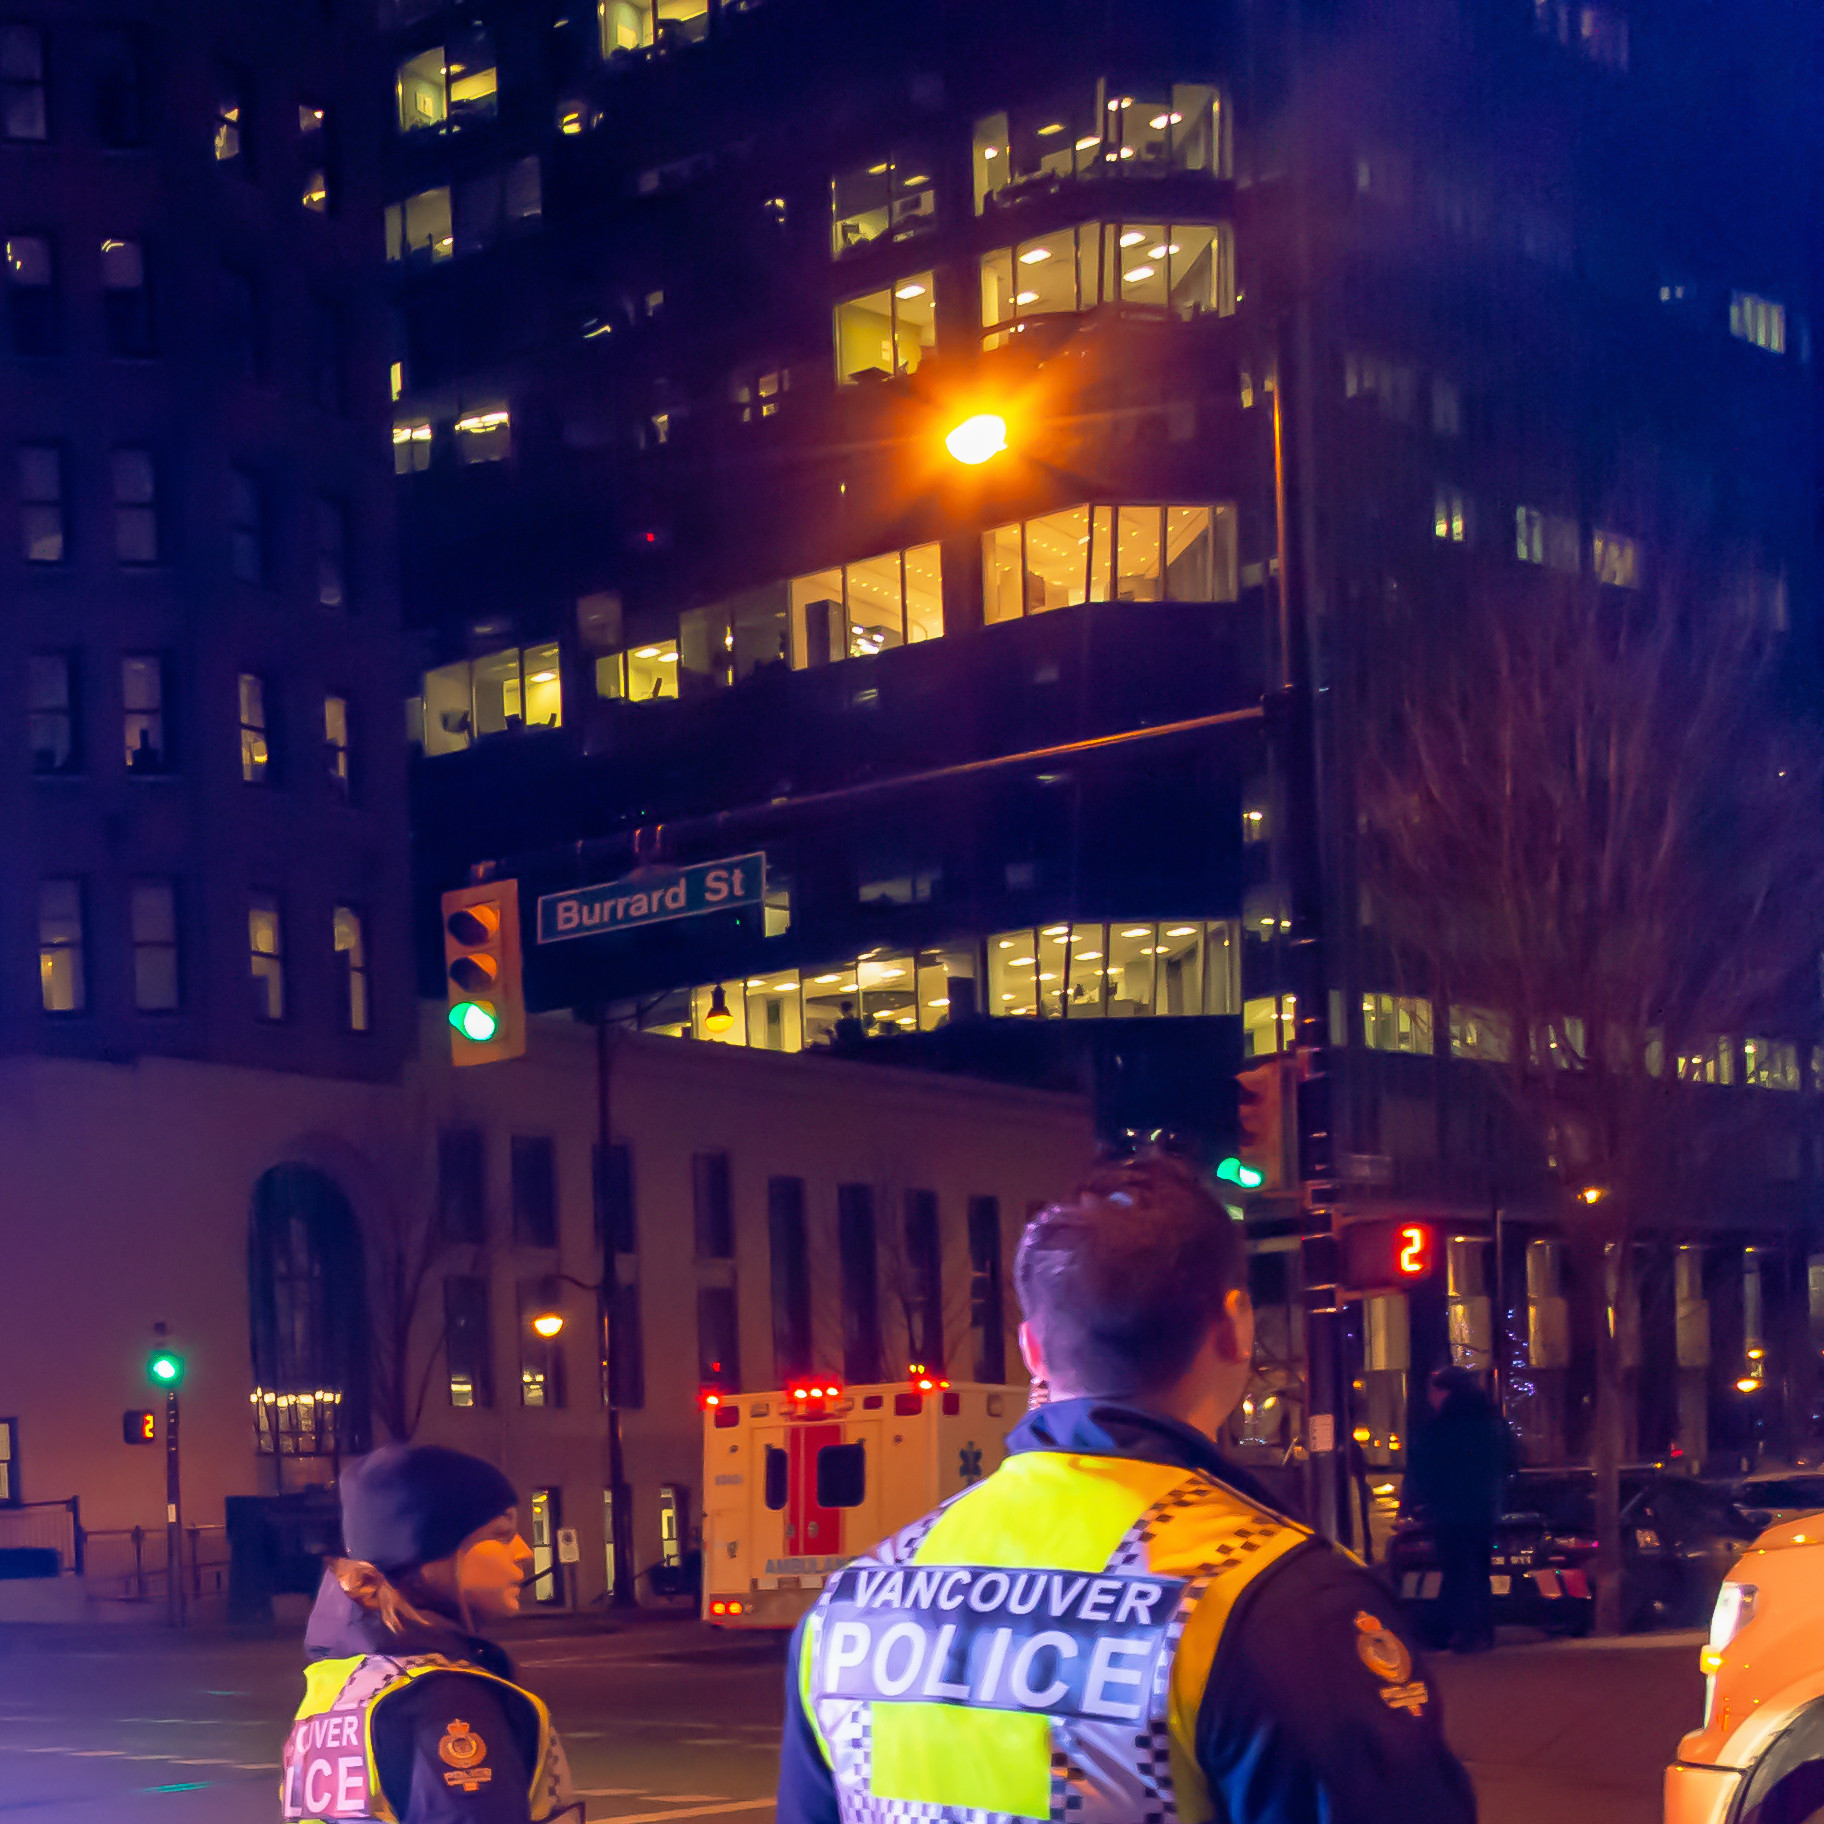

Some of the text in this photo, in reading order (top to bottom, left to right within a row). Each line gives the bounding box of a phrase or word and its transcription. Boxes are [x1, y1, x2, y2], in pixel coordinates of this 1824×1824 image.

[557, 869, 745, 931] Burrard St
[1400, 1228, 1421, 1272] 2
[142, 1413, 154, 1438] 2
[853, 1570, 1162, 1625] VANCOUVER
[826, 1621, 1152, 1720] POLICE
